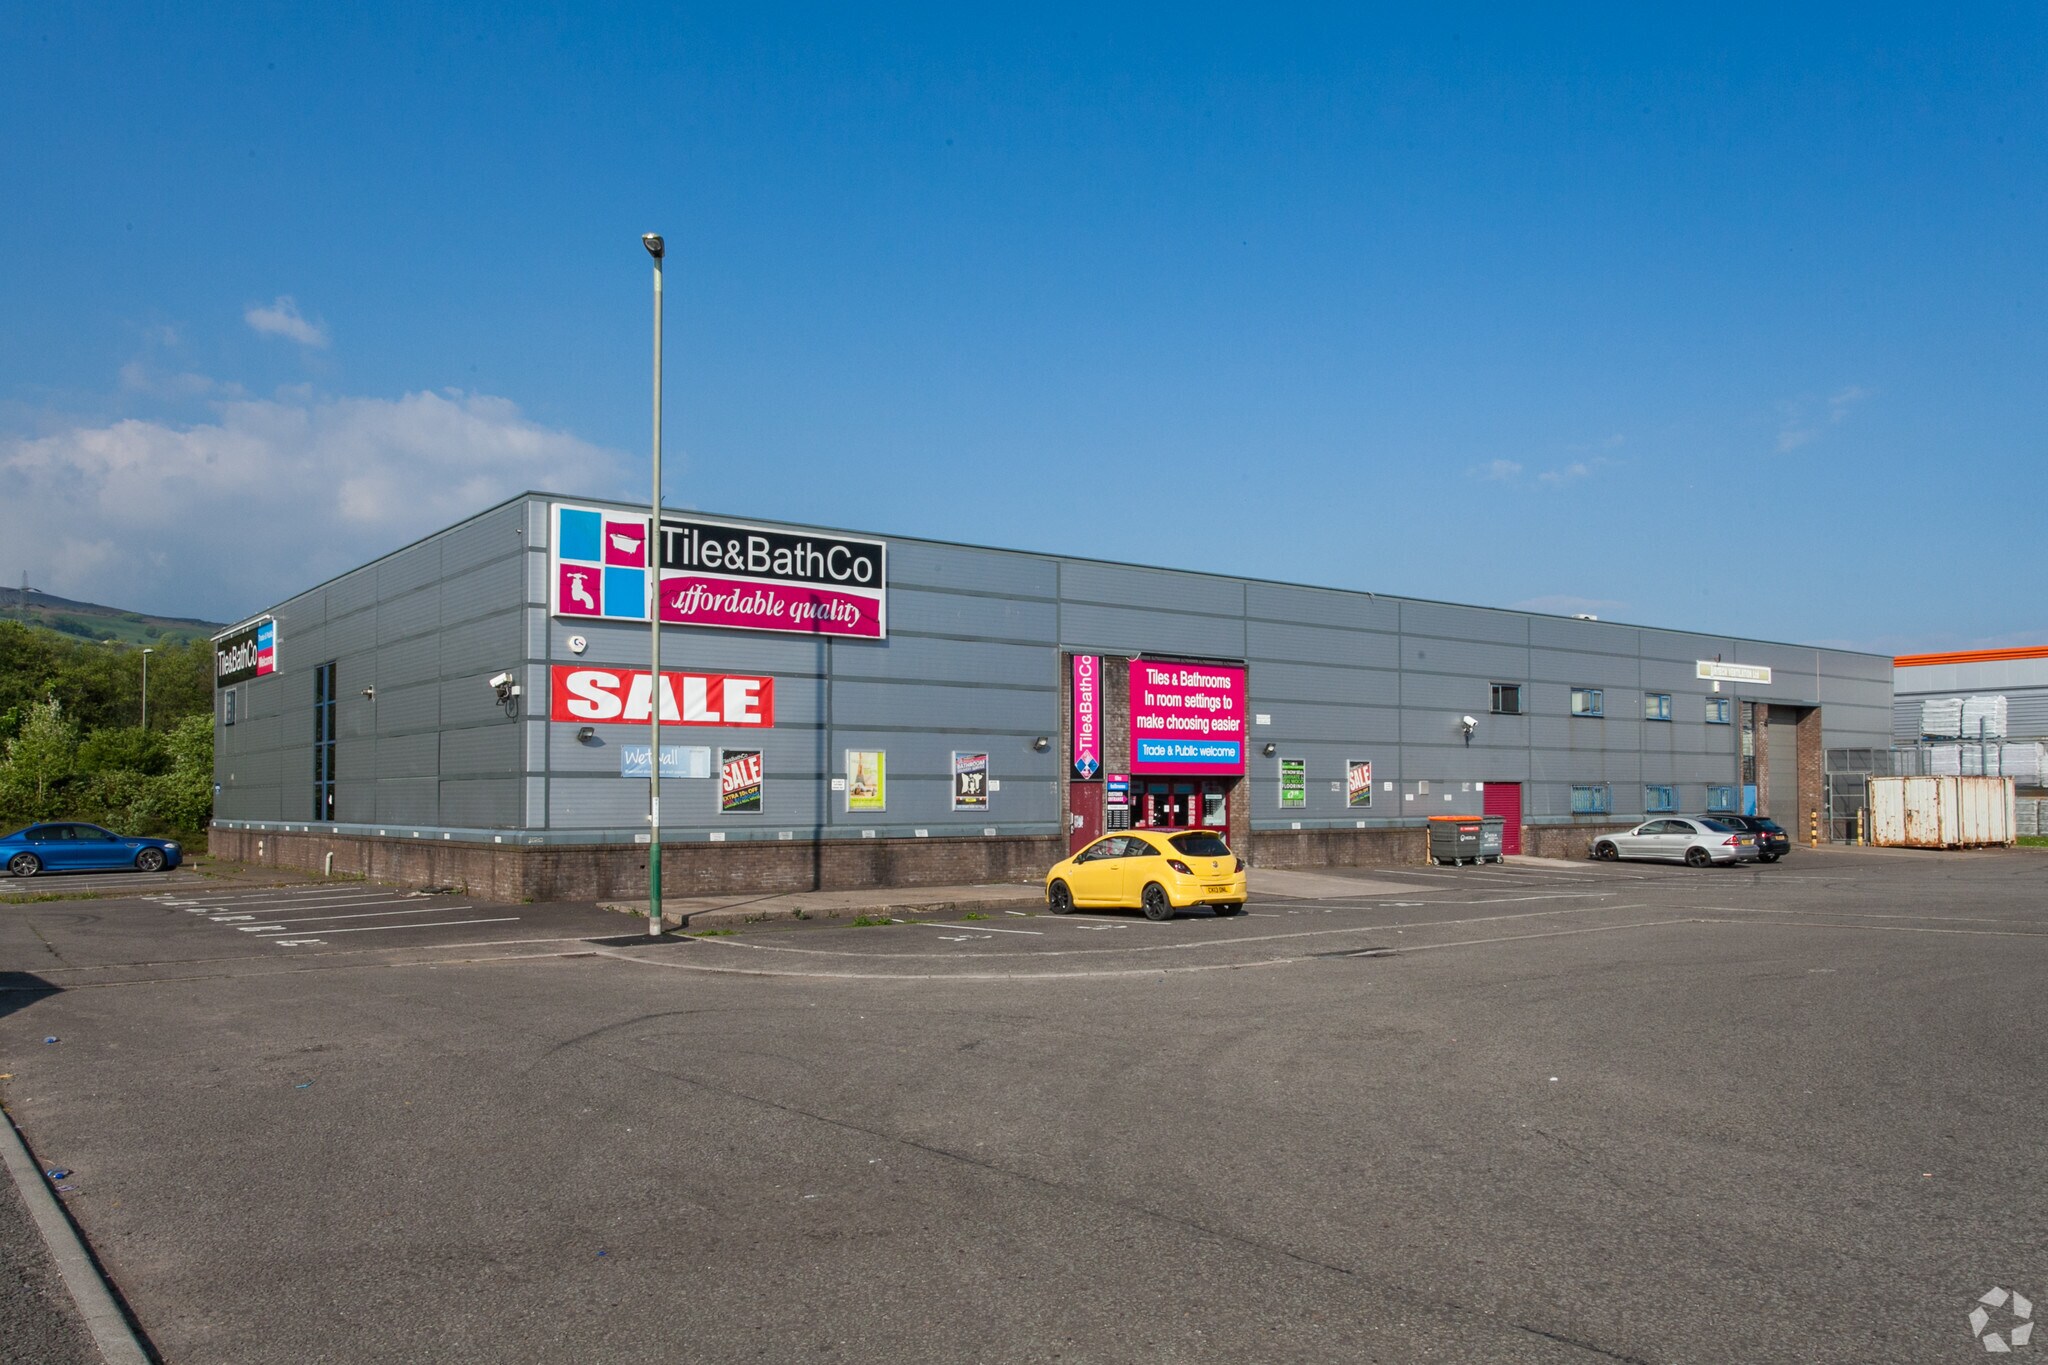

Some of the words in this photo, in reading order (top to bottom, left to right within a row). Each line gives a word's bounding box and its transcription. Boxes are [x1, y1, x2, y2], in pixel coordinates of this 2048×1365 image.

[660, 525, 873, 583] Tile&BathCo
[671, 583, 785, 617] affordable
[789, 599, 861, 628] quality
[1146, 668, 1169, 685] Tiles
[1172, 673, 1178, 686] &
[1180, 671, 1231, 688] Bathrooms
[566, 670, 762, 723] SALE
[1079, 655, 1093, 751] Tile&BathCo
[1145, 690, 1154, 706] In
[1156, 694, 1182, 707] room
[1184, 693, 1221, 712] settings
[1223, 695, 1232, 709] to
[1137, 713, 1164, 729] make
[1166, 714, 1209, 734] choosing
[1211, 716, 1240, 731] easier
[1143, 744, 1165, 756] Trade
[1167, 745, 1173, 756] &
[1175, 745, 1198, 756] Public
[1200, 746, 1235, 757] welcome
[723, 757, 761, 791] SALE
[1350, 765, 1371, 790] SALE
